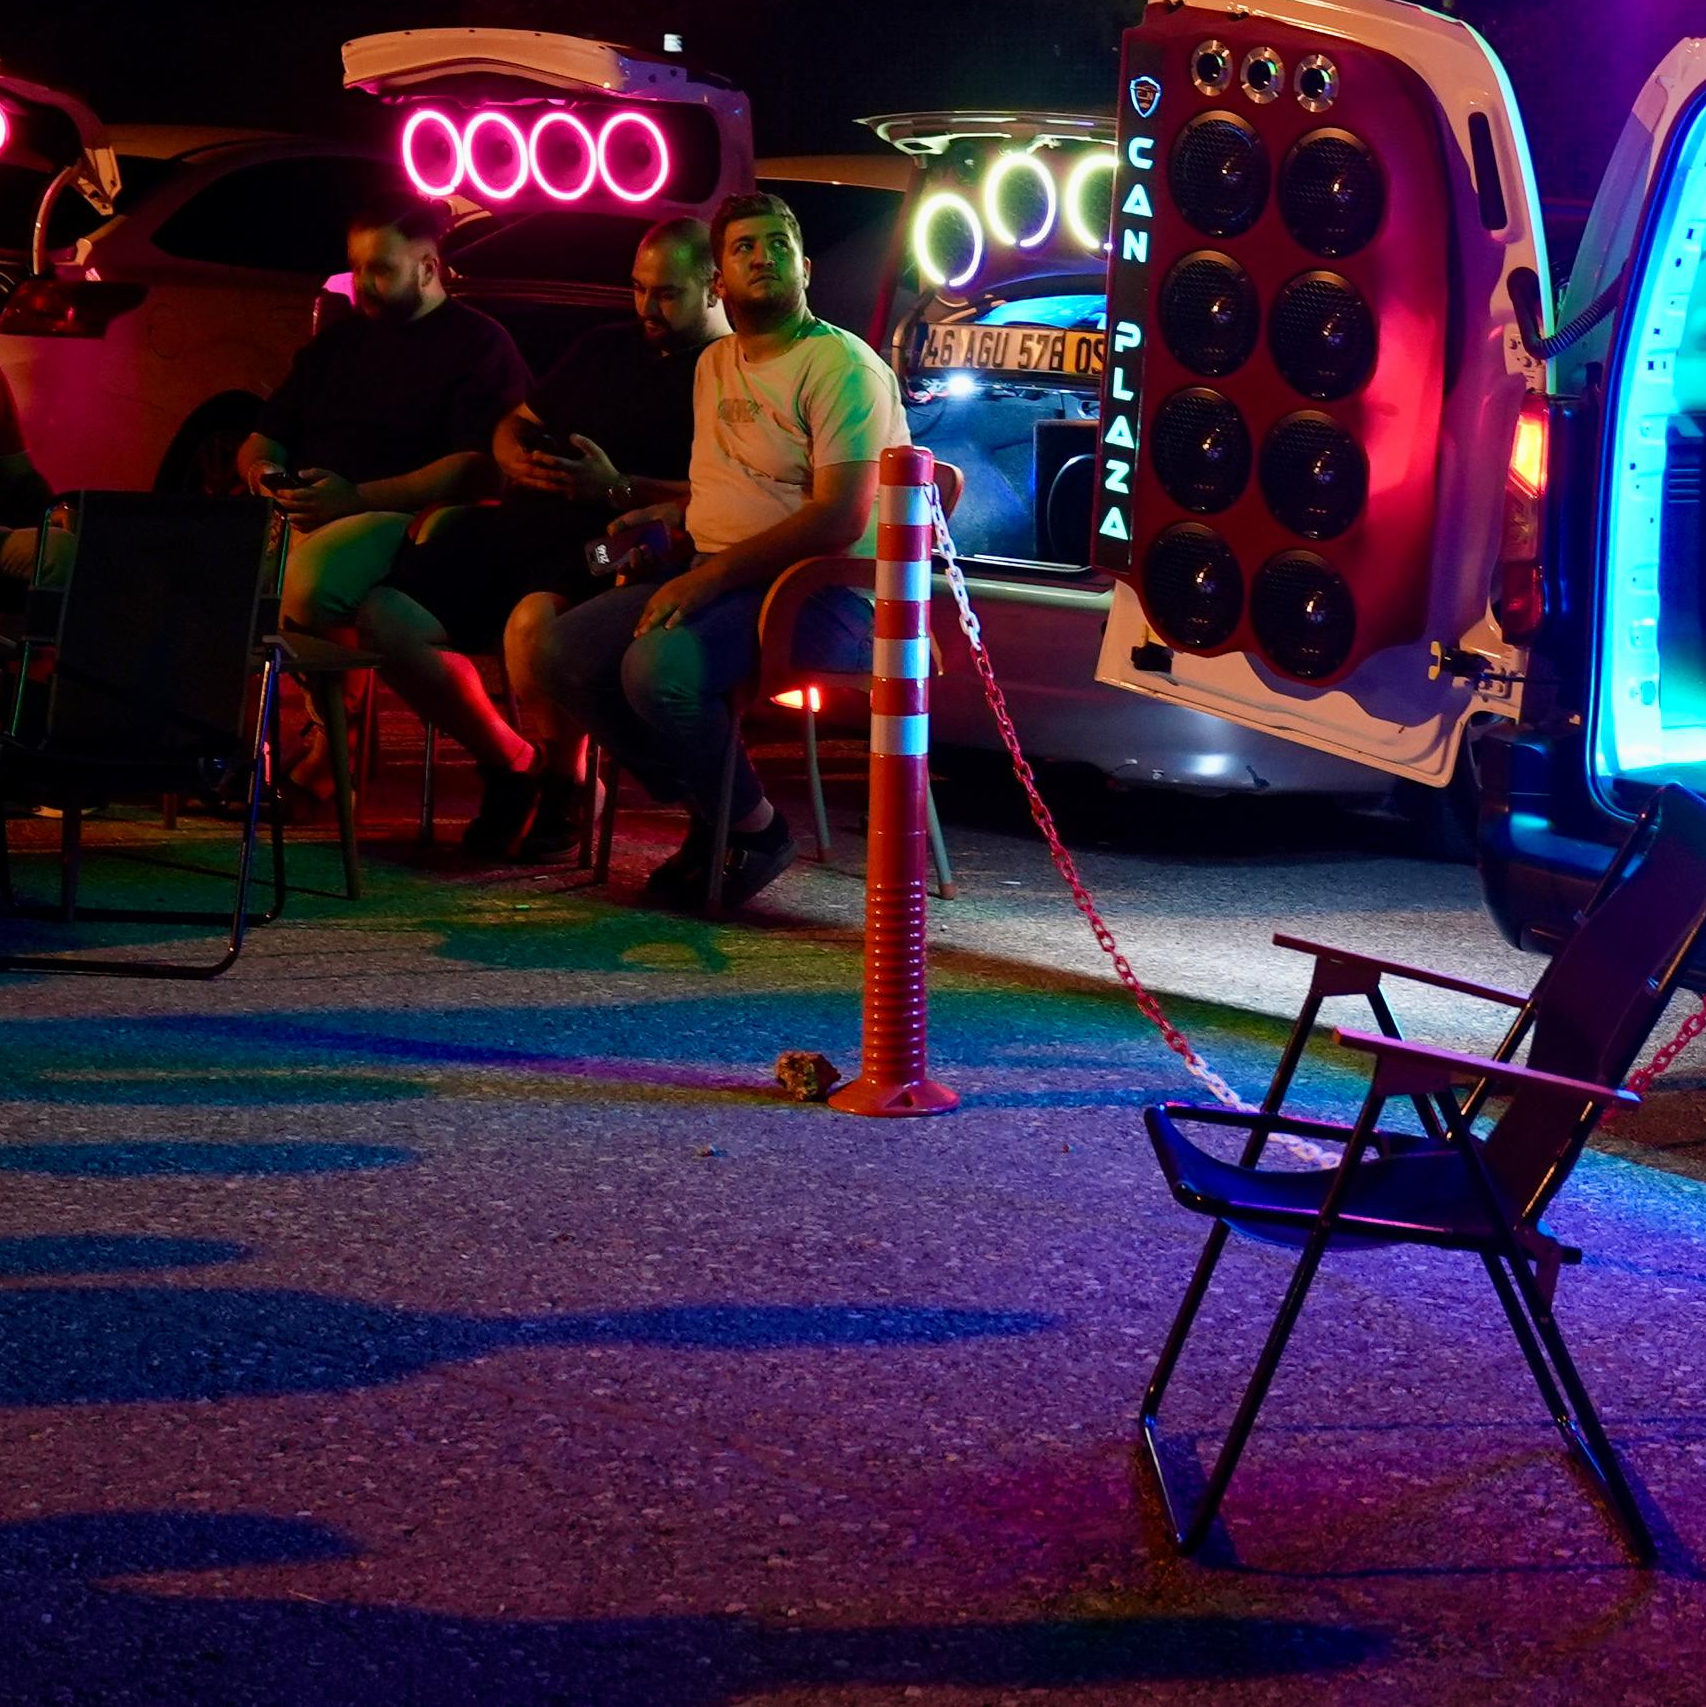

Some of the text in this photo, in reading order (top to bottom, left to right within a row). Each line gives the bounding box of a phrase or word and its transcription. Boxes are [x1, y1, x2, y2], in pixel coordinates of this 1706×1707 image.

[964, 331, 1009, 367] AGU
[1099, 138, 1154, 540] CAN PLAZA
